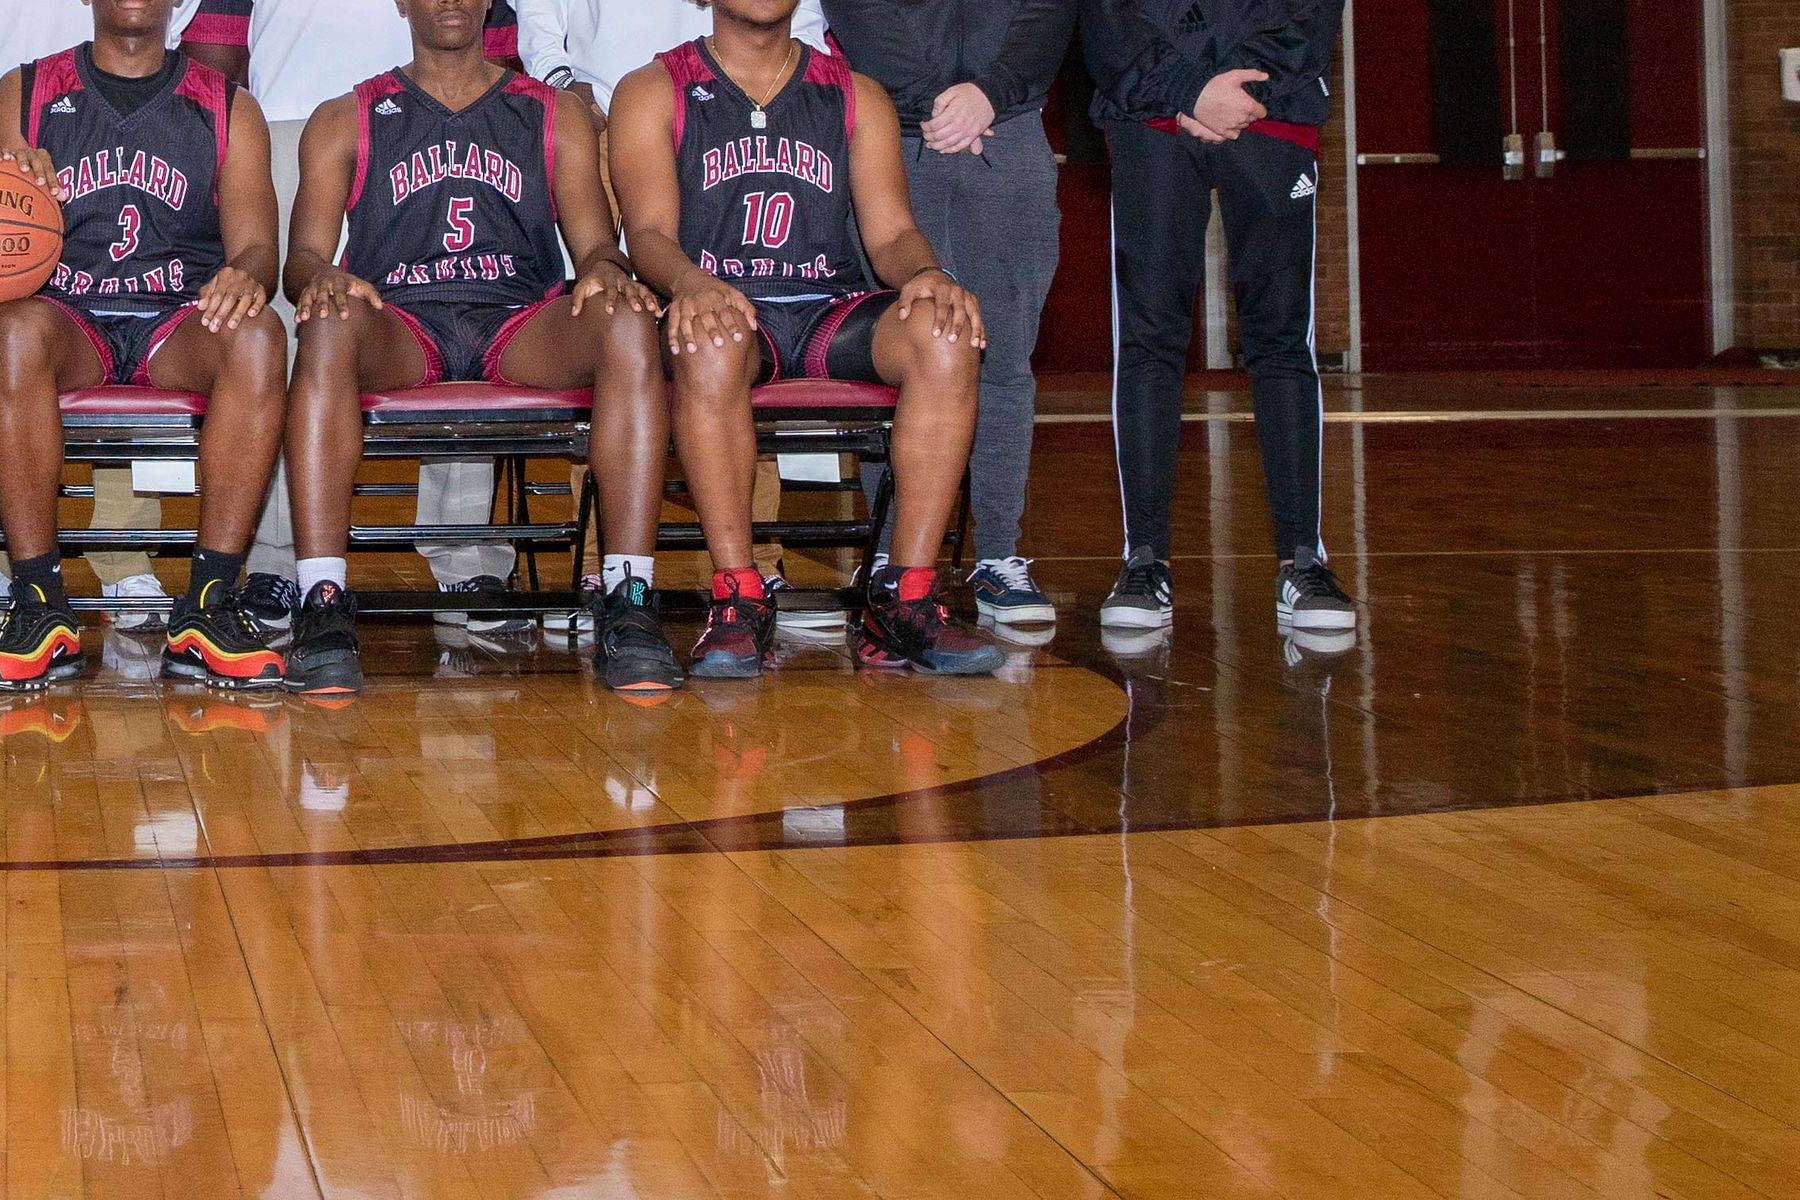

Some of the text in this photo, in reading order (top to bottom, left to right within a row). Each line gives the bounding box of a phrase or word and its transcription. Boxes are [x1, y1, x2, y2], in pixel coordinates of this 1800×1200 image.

[58, 147, 188, 211] BALLARD
[390, 140, 522, 206] BALLARD
[703, 135, 833, 193] BALLARD
[109, 204, 141, 261] 3
[443, 197, 475, 253] 5
[741, 191, 795, 249] 10
